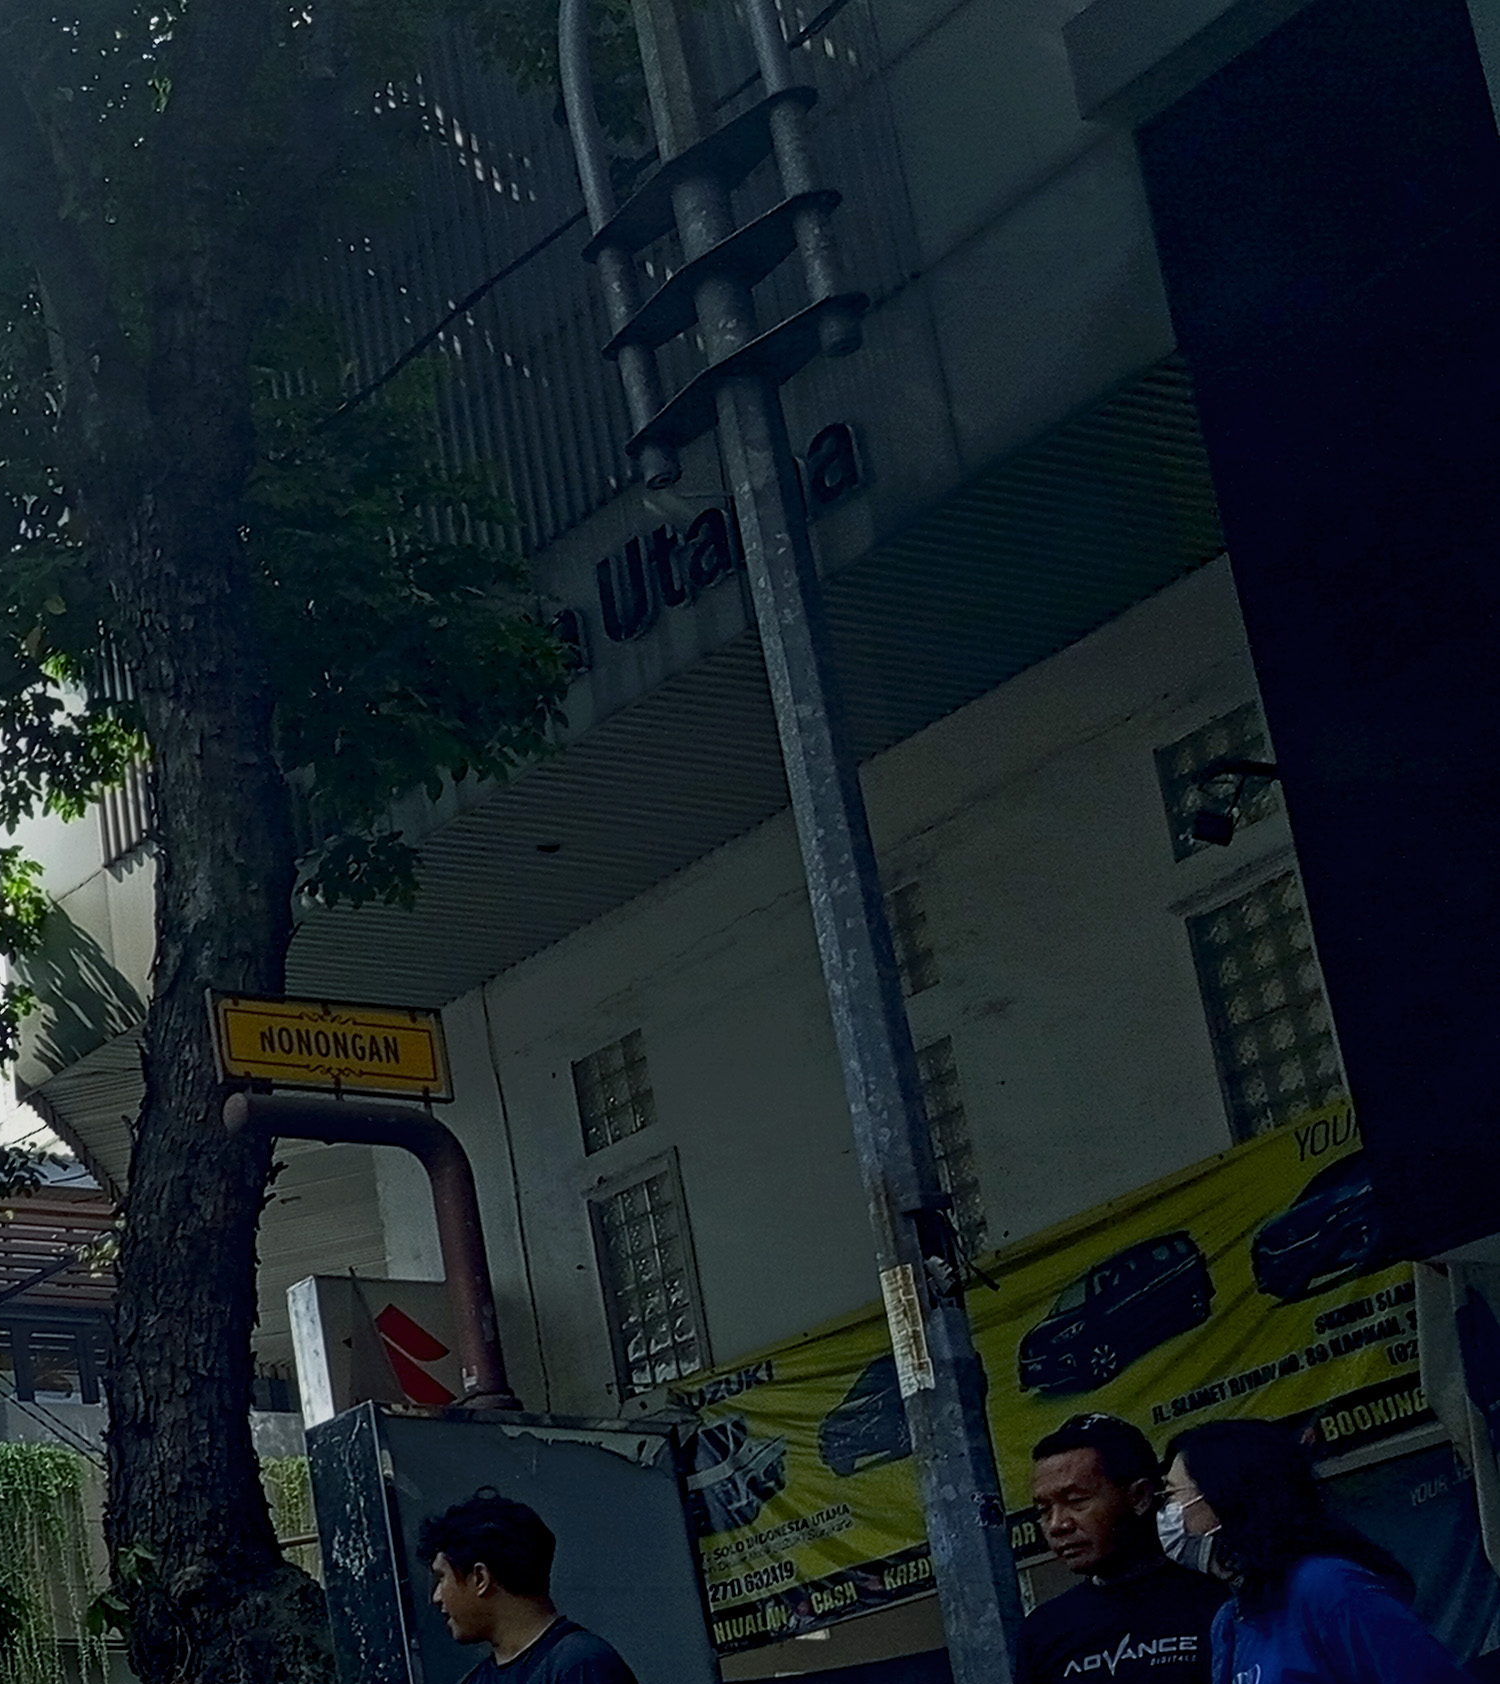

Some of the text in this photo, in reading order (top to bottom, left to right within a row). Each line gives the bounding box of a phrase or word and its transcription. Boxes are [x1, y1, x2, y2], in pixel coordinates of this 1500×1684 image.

[597, 423, 863, 642] Utaa
[260, 1026, 400, 1064] NONONGAN
[1295, 1108, 1358, 1161] YOU
[1171, 1385, 1226, 1418] SLAMET
[1319, 1385, 1430, 1443] BOOKING
[714, 1541, 745, 1560] SOLO
[812, 1503, 851, 1527] UTAMA
[810, 1580, 859, 1616] CASH
[1063, 1633, 1198, 1677] ADVANCE
